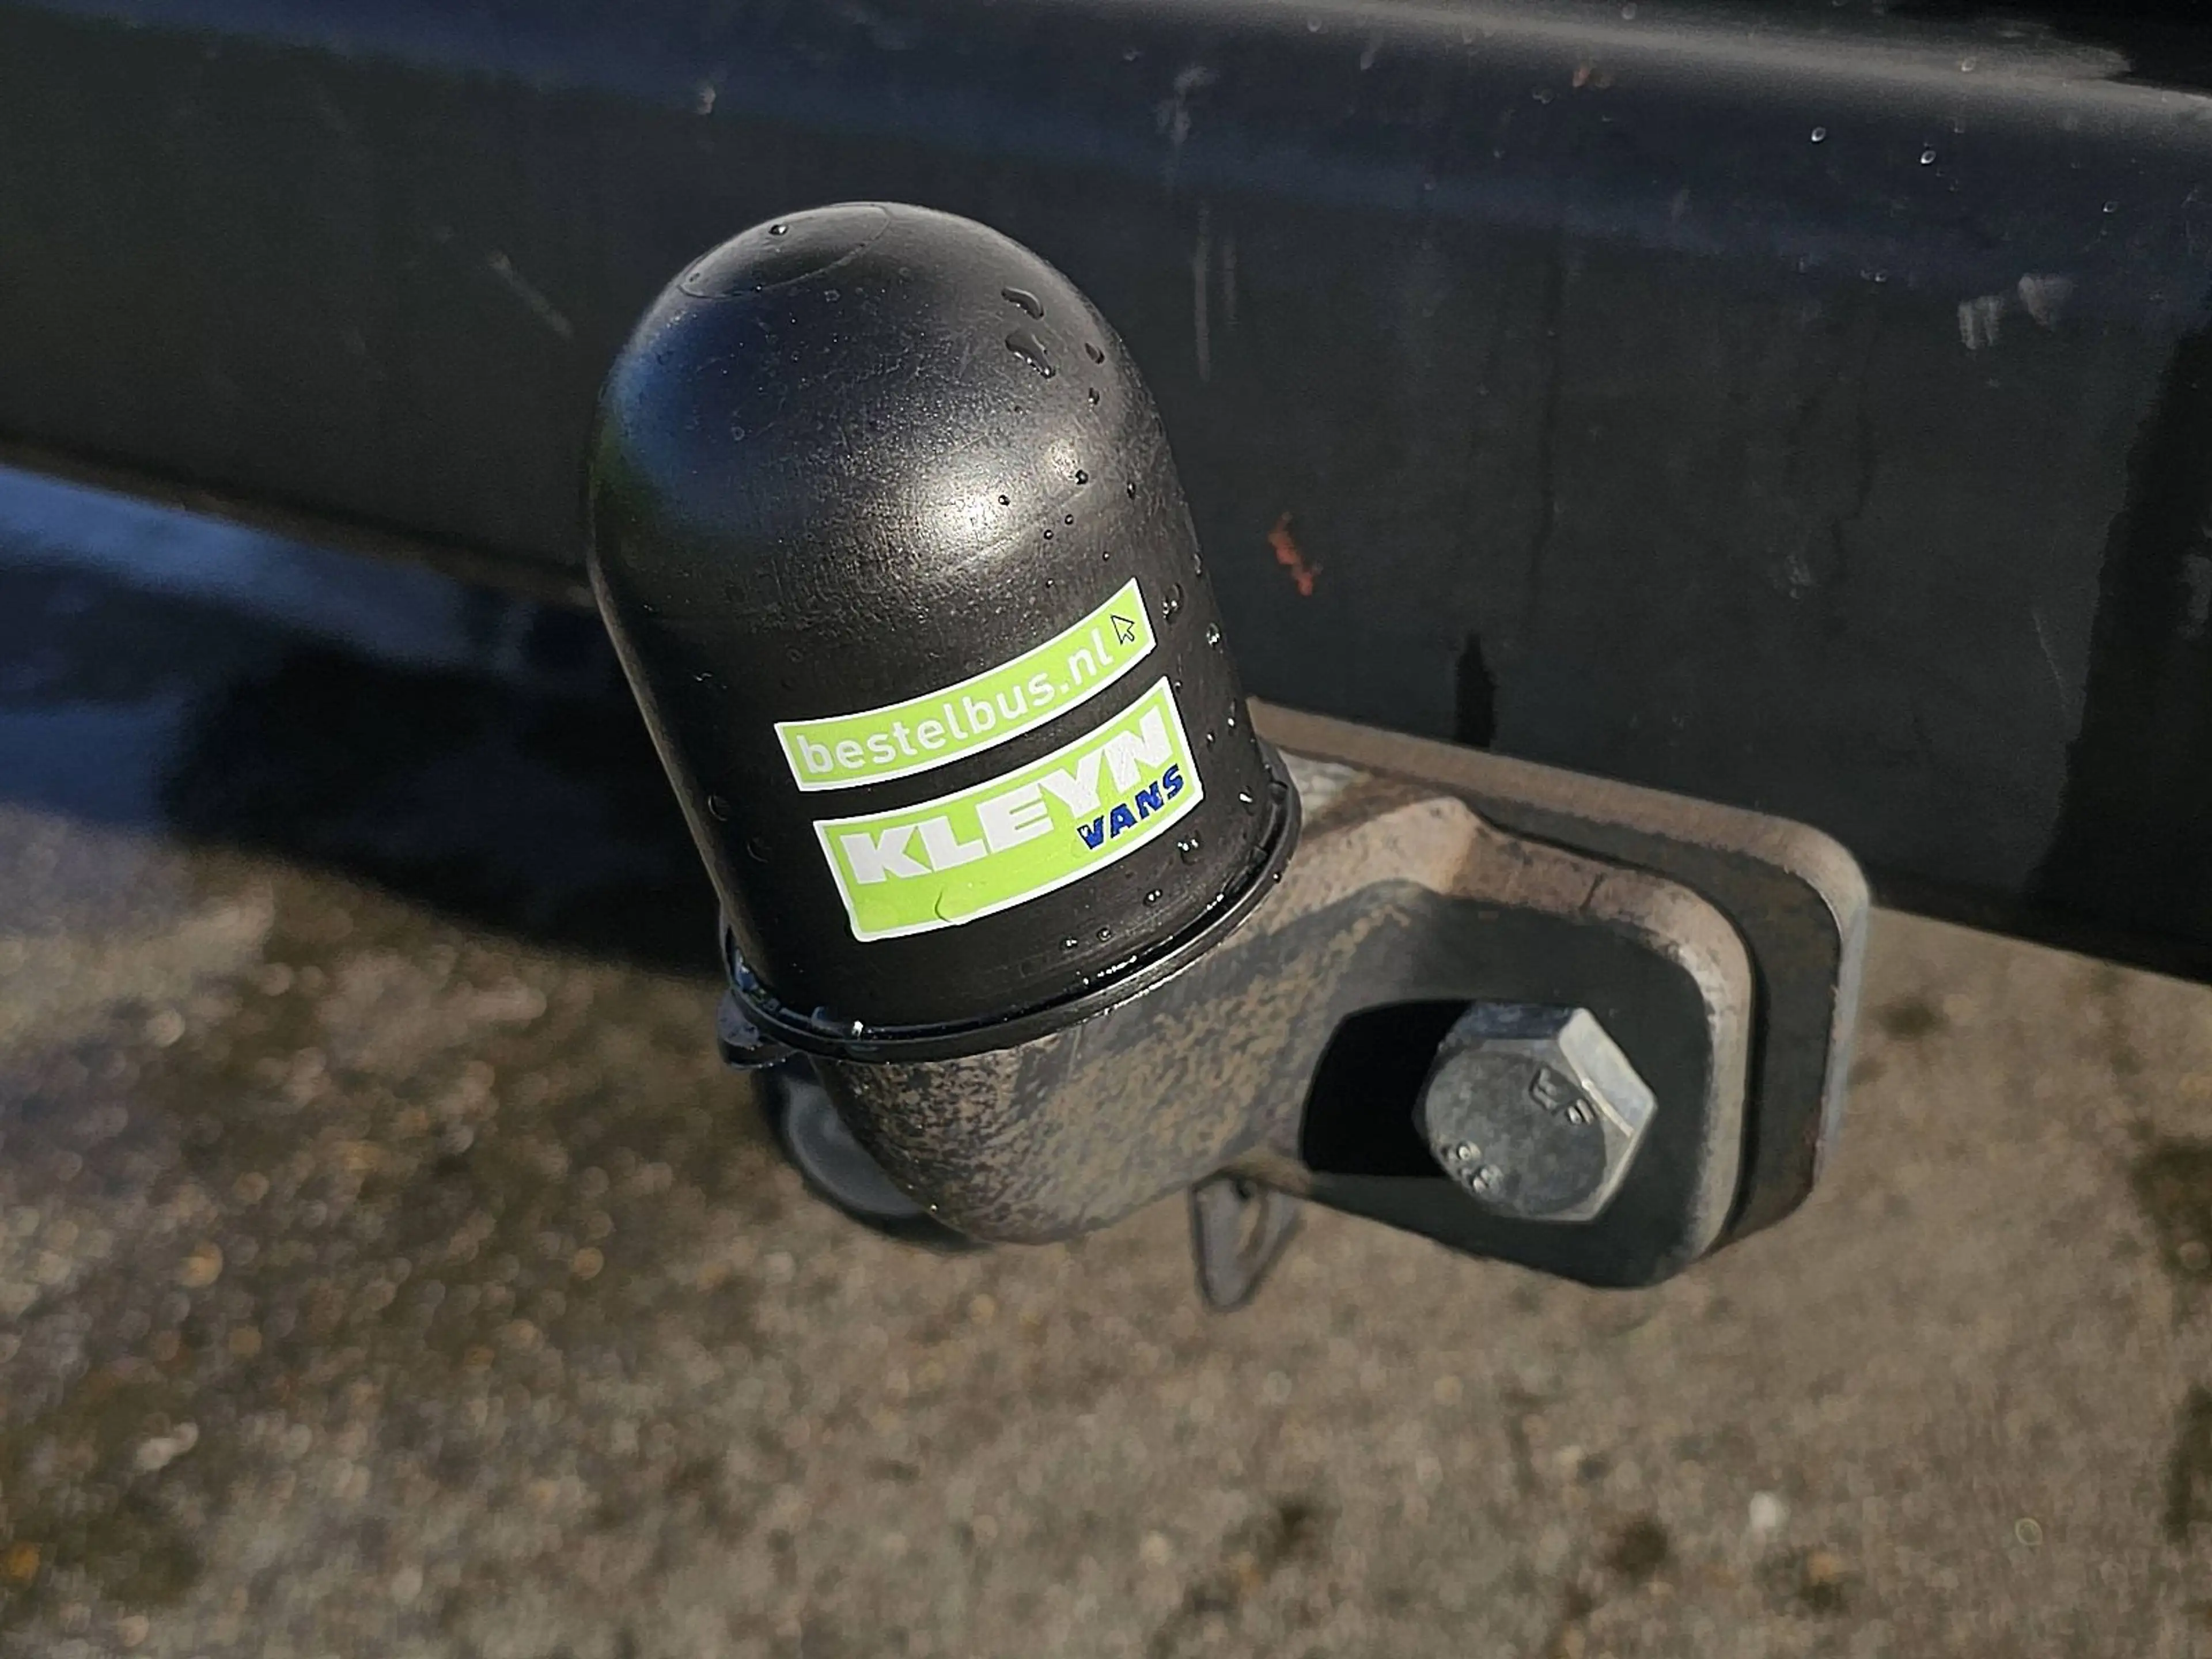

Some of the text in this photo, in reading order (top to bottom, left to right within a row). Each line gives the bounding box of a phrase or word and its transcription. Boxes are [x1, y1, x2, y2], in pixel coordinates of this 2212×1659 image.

[797, 627, 1113, 774] bestelbus.nl
[839, 705, 1173, 885] KLEYN
[1077, 763, 1184, 850] VANS
